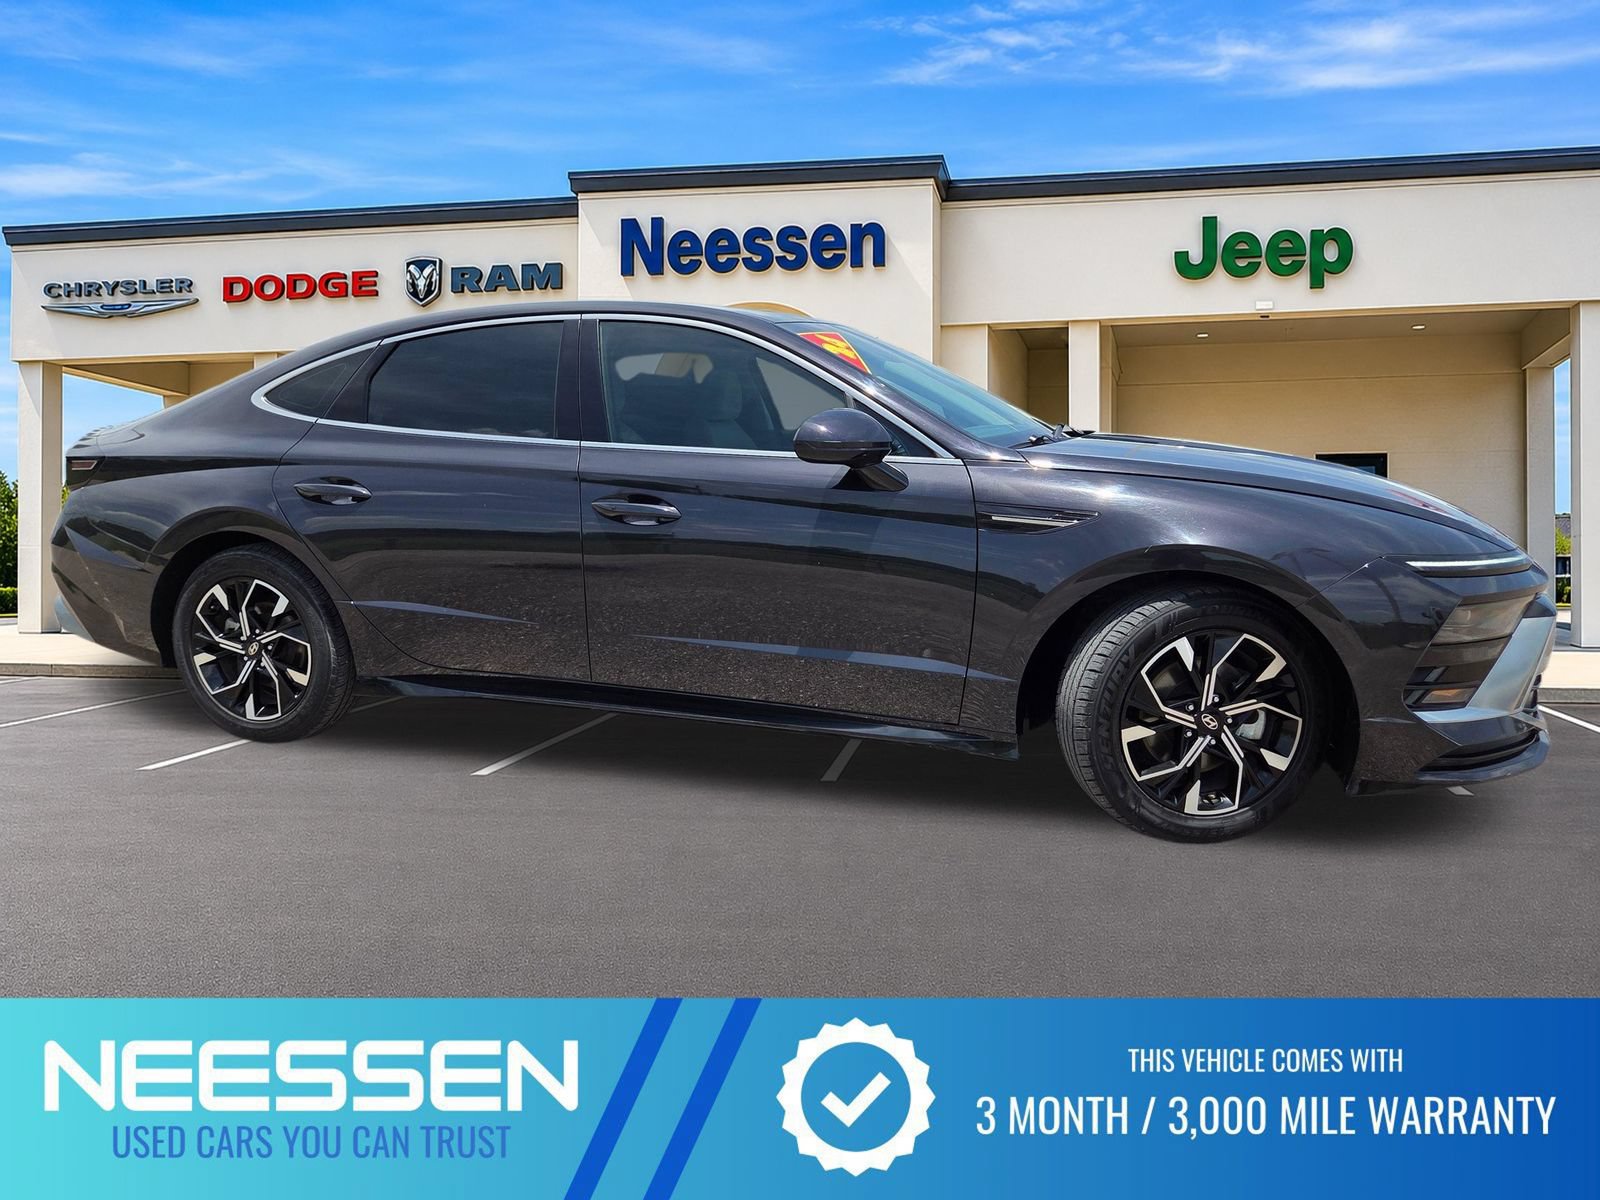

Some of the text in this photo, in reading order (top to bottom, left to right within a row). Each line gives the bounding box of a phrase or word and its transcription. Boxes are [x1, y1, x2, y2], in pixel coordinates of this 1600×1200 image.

[620, 216, 886, 277] Neessen
[1174, 215, 1354, 289] Jeep
[43, 277, 194, 299] CHRYSLER
[223, 271, 379, 303] DODGE
[451, 263, 564, 294] RAM
